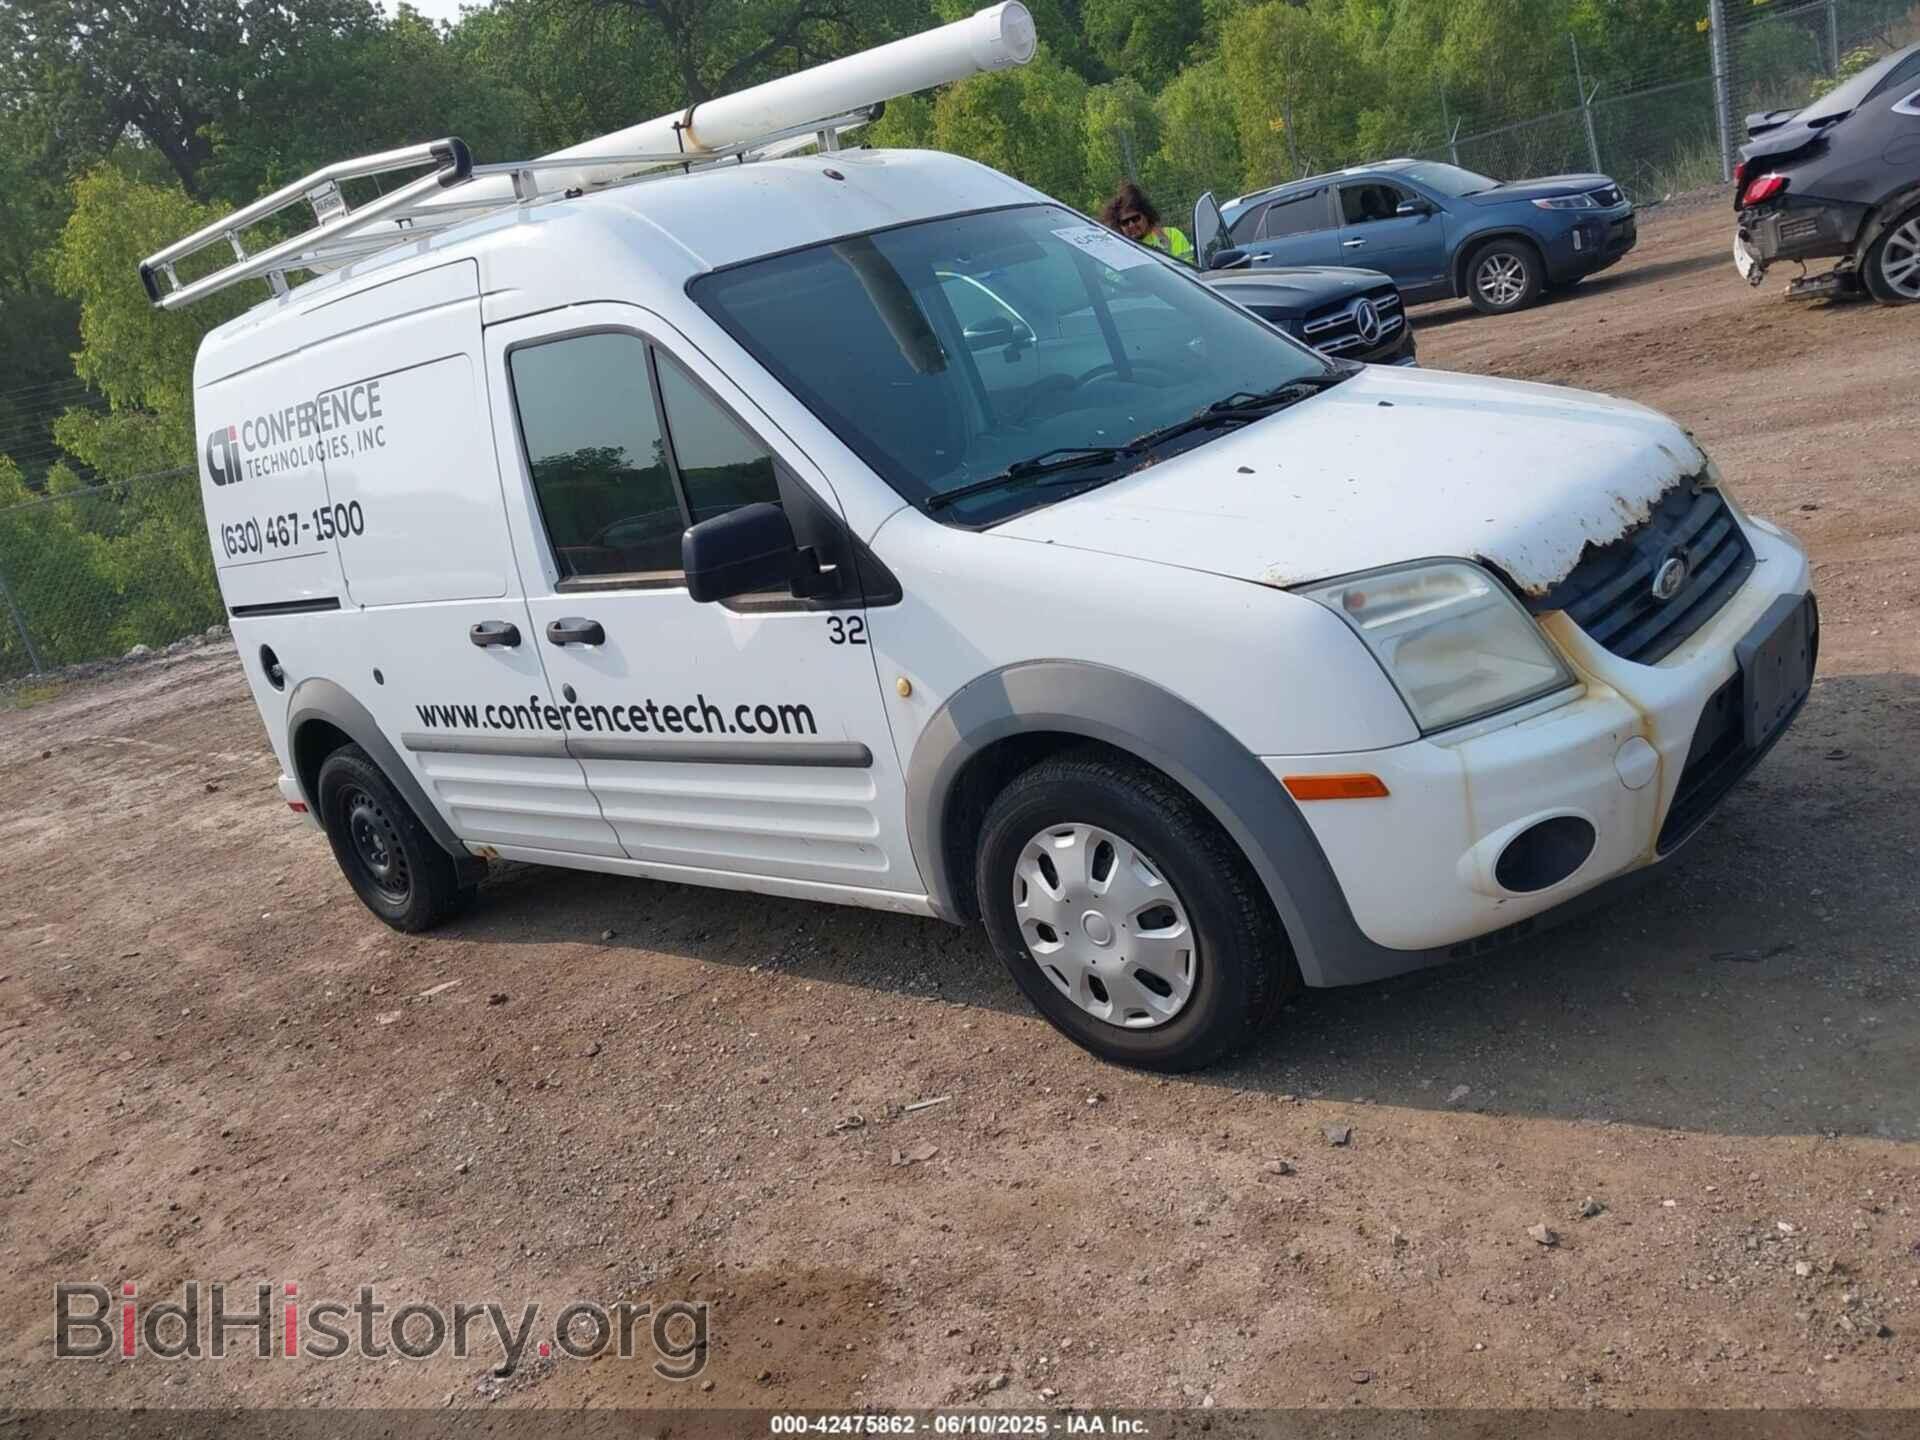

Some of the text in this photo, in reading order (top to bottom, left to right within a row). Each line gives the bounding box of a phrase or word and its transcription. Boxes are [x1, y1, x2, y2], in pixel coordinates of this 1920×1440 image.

[242, 381, 383, 452] CONFERENCE
[356, 425, 386, 452] INC
[221, 500, 364, 559] (630) 467-1500
[827, 616, 867, 644] 32
[416, 694, 818, 734] www.conferencetech.com
